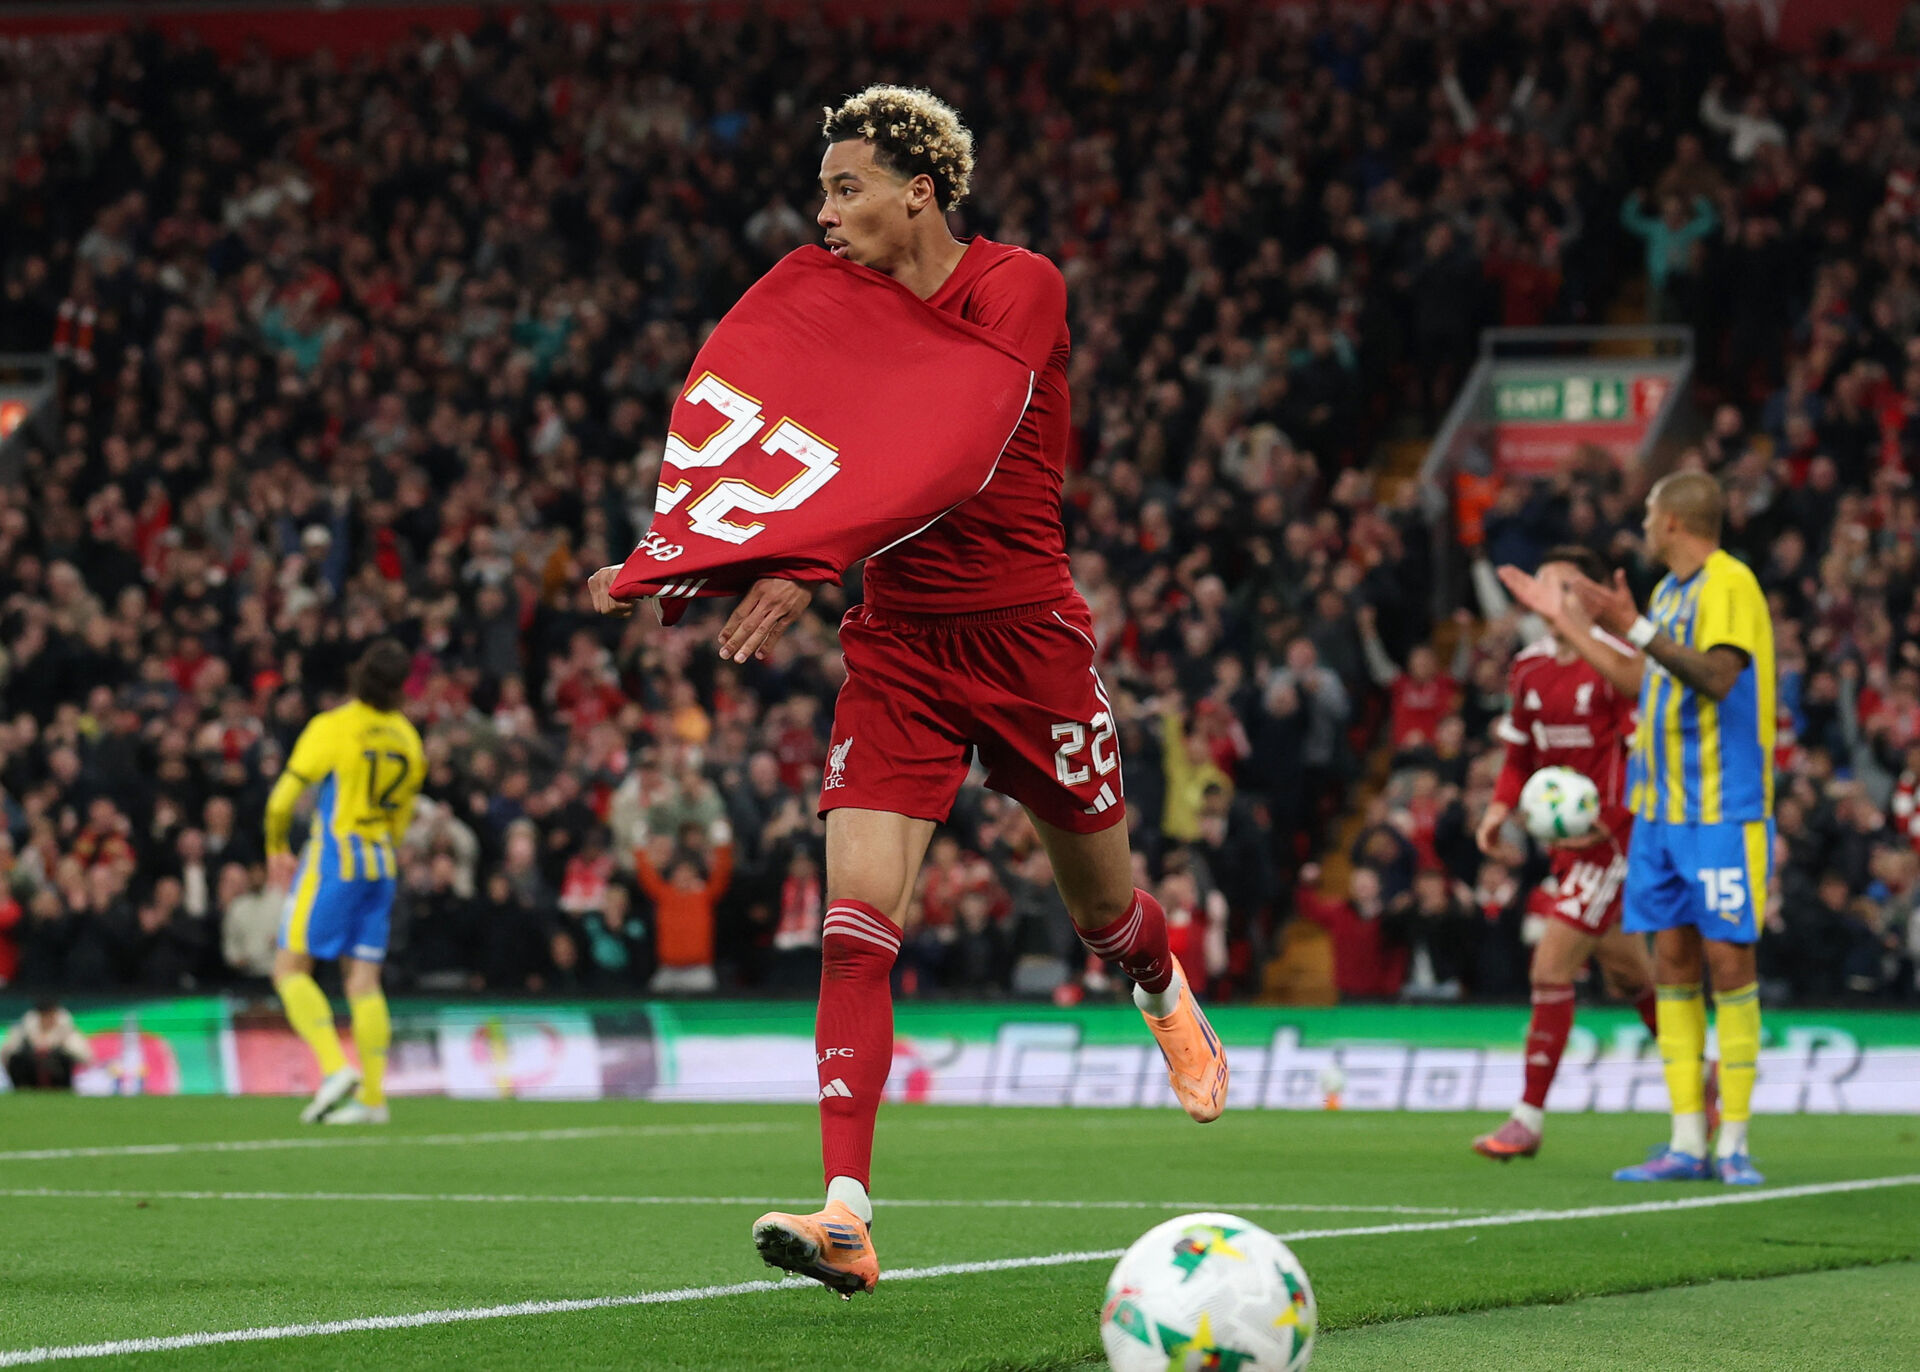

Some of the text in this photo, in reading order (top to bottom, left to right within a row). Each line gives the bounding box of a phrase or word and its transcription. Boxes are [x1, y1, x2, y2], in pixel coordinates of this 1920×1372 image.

[655, 370, 841, 546] 22
[1051, 711, 1117, 787] 22
[364, 750, 411, 809] 12
[1697, 867, 1746, 911] 15
[816, 1047, 855, 1066] LFC
